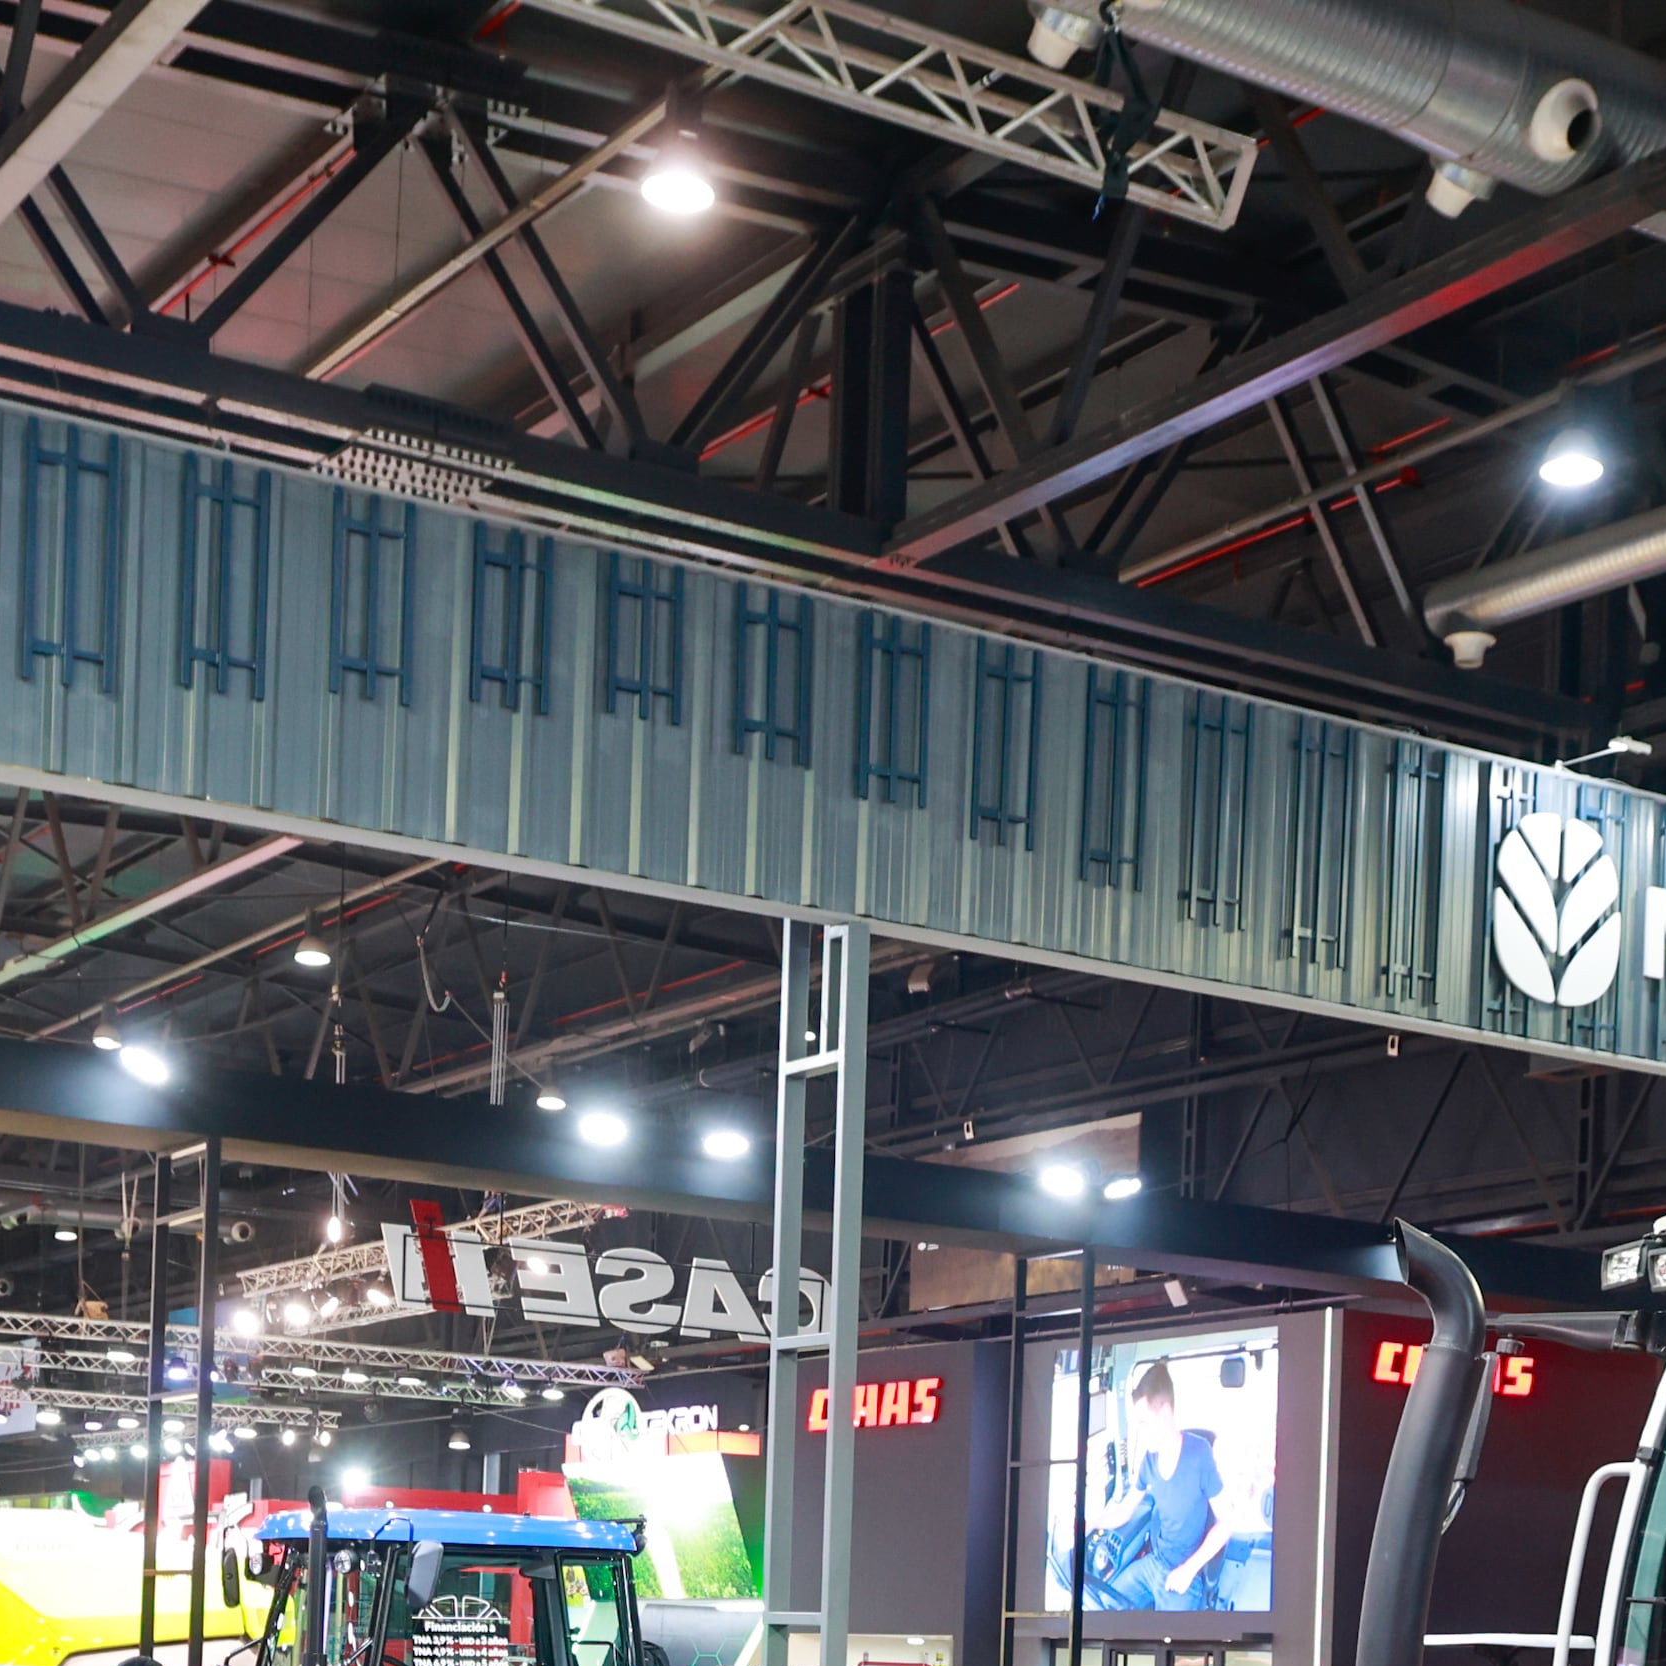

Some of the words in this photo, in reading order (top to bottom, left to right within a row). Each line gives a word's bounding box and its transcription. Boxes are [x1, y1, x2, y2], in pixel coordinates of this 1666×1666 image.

[1374, 1341, 1534, 1395] CLS
[807, 1377, 941, 1432] CAAS
[424, 1621, 488, 1633] Financiación
[489, 1623, 496, 1633] a
[413, 1635, 432, 1645] TNA
[413, 1647, 432, 1657] TNA
